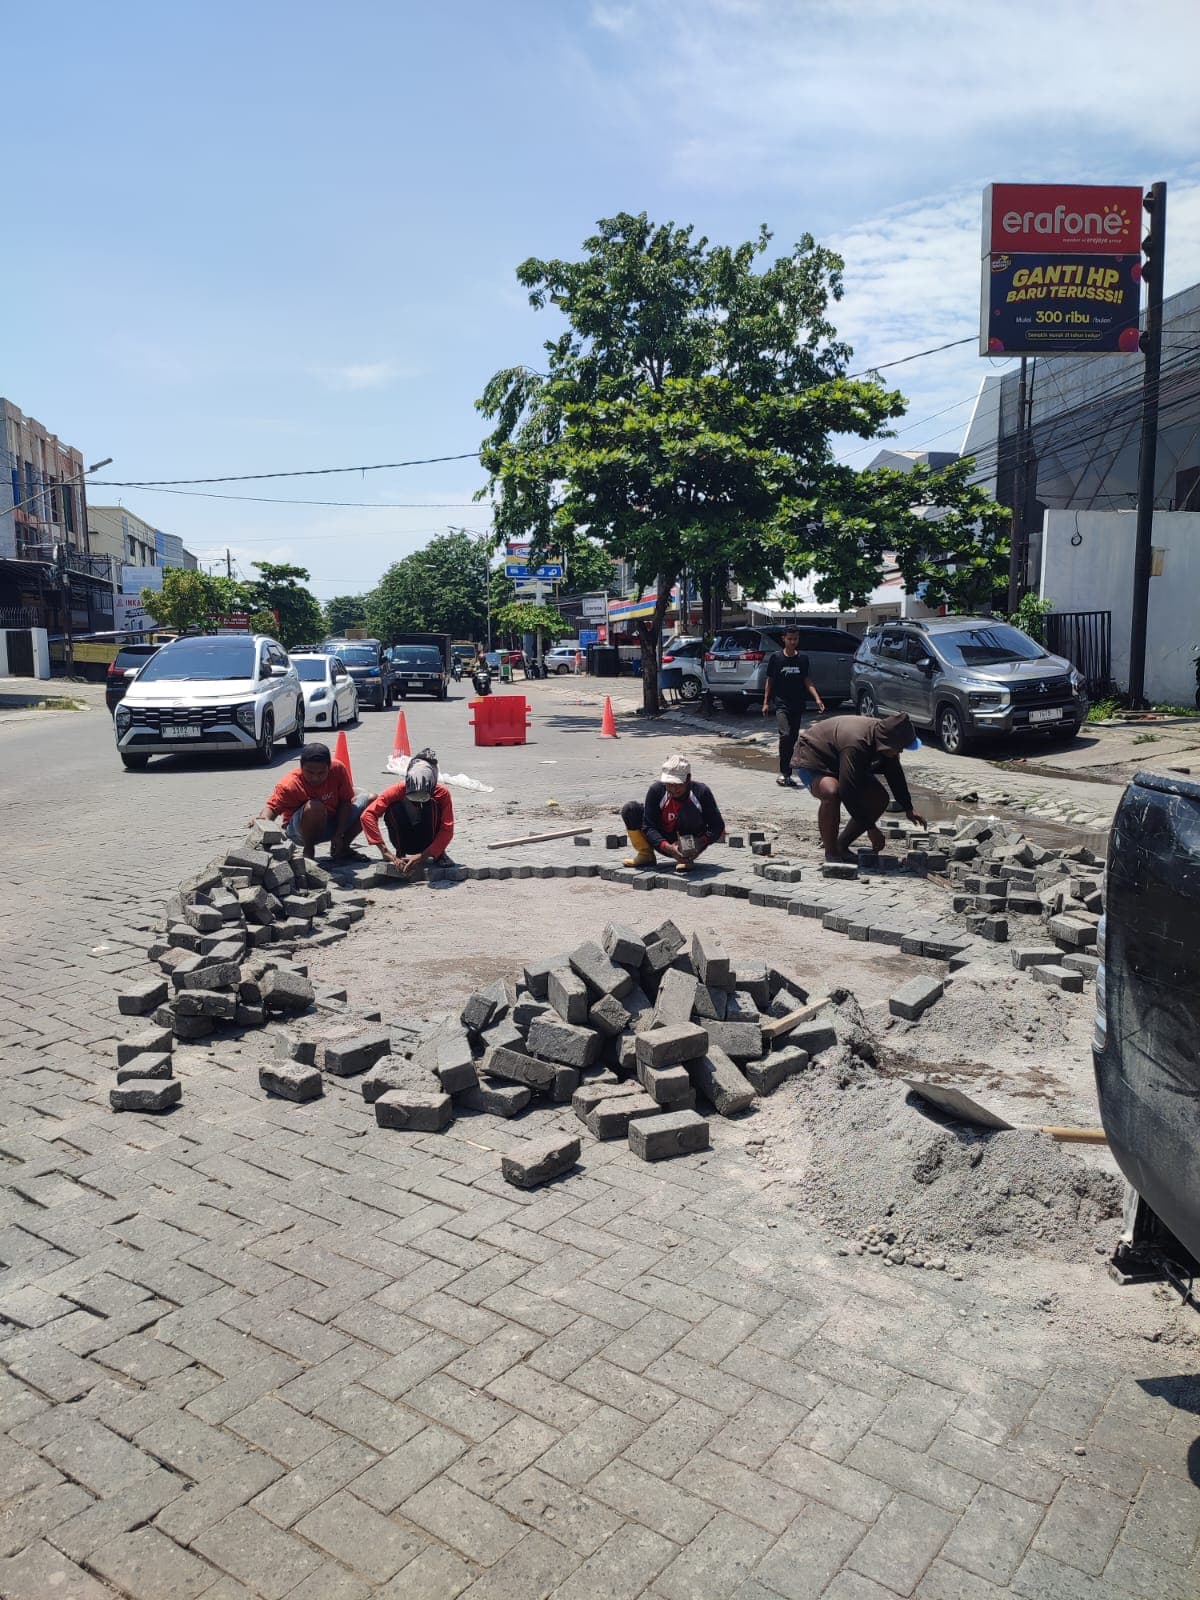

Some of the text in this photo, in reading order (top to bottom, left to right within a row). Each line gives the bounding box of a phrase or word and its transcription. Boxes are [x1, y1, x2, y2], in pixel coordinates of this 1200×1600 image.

[1002, 205, 1123, 235] erafone
[1012, 265, 1083, 287] GANTI
[1086, 267, 1120, 288] HP
[1006, 286, 1124, 304] BARU TERUSSS!!
[1035, 310, 1062, 324] 300
[1065, 310, 1090, 324] ribu
